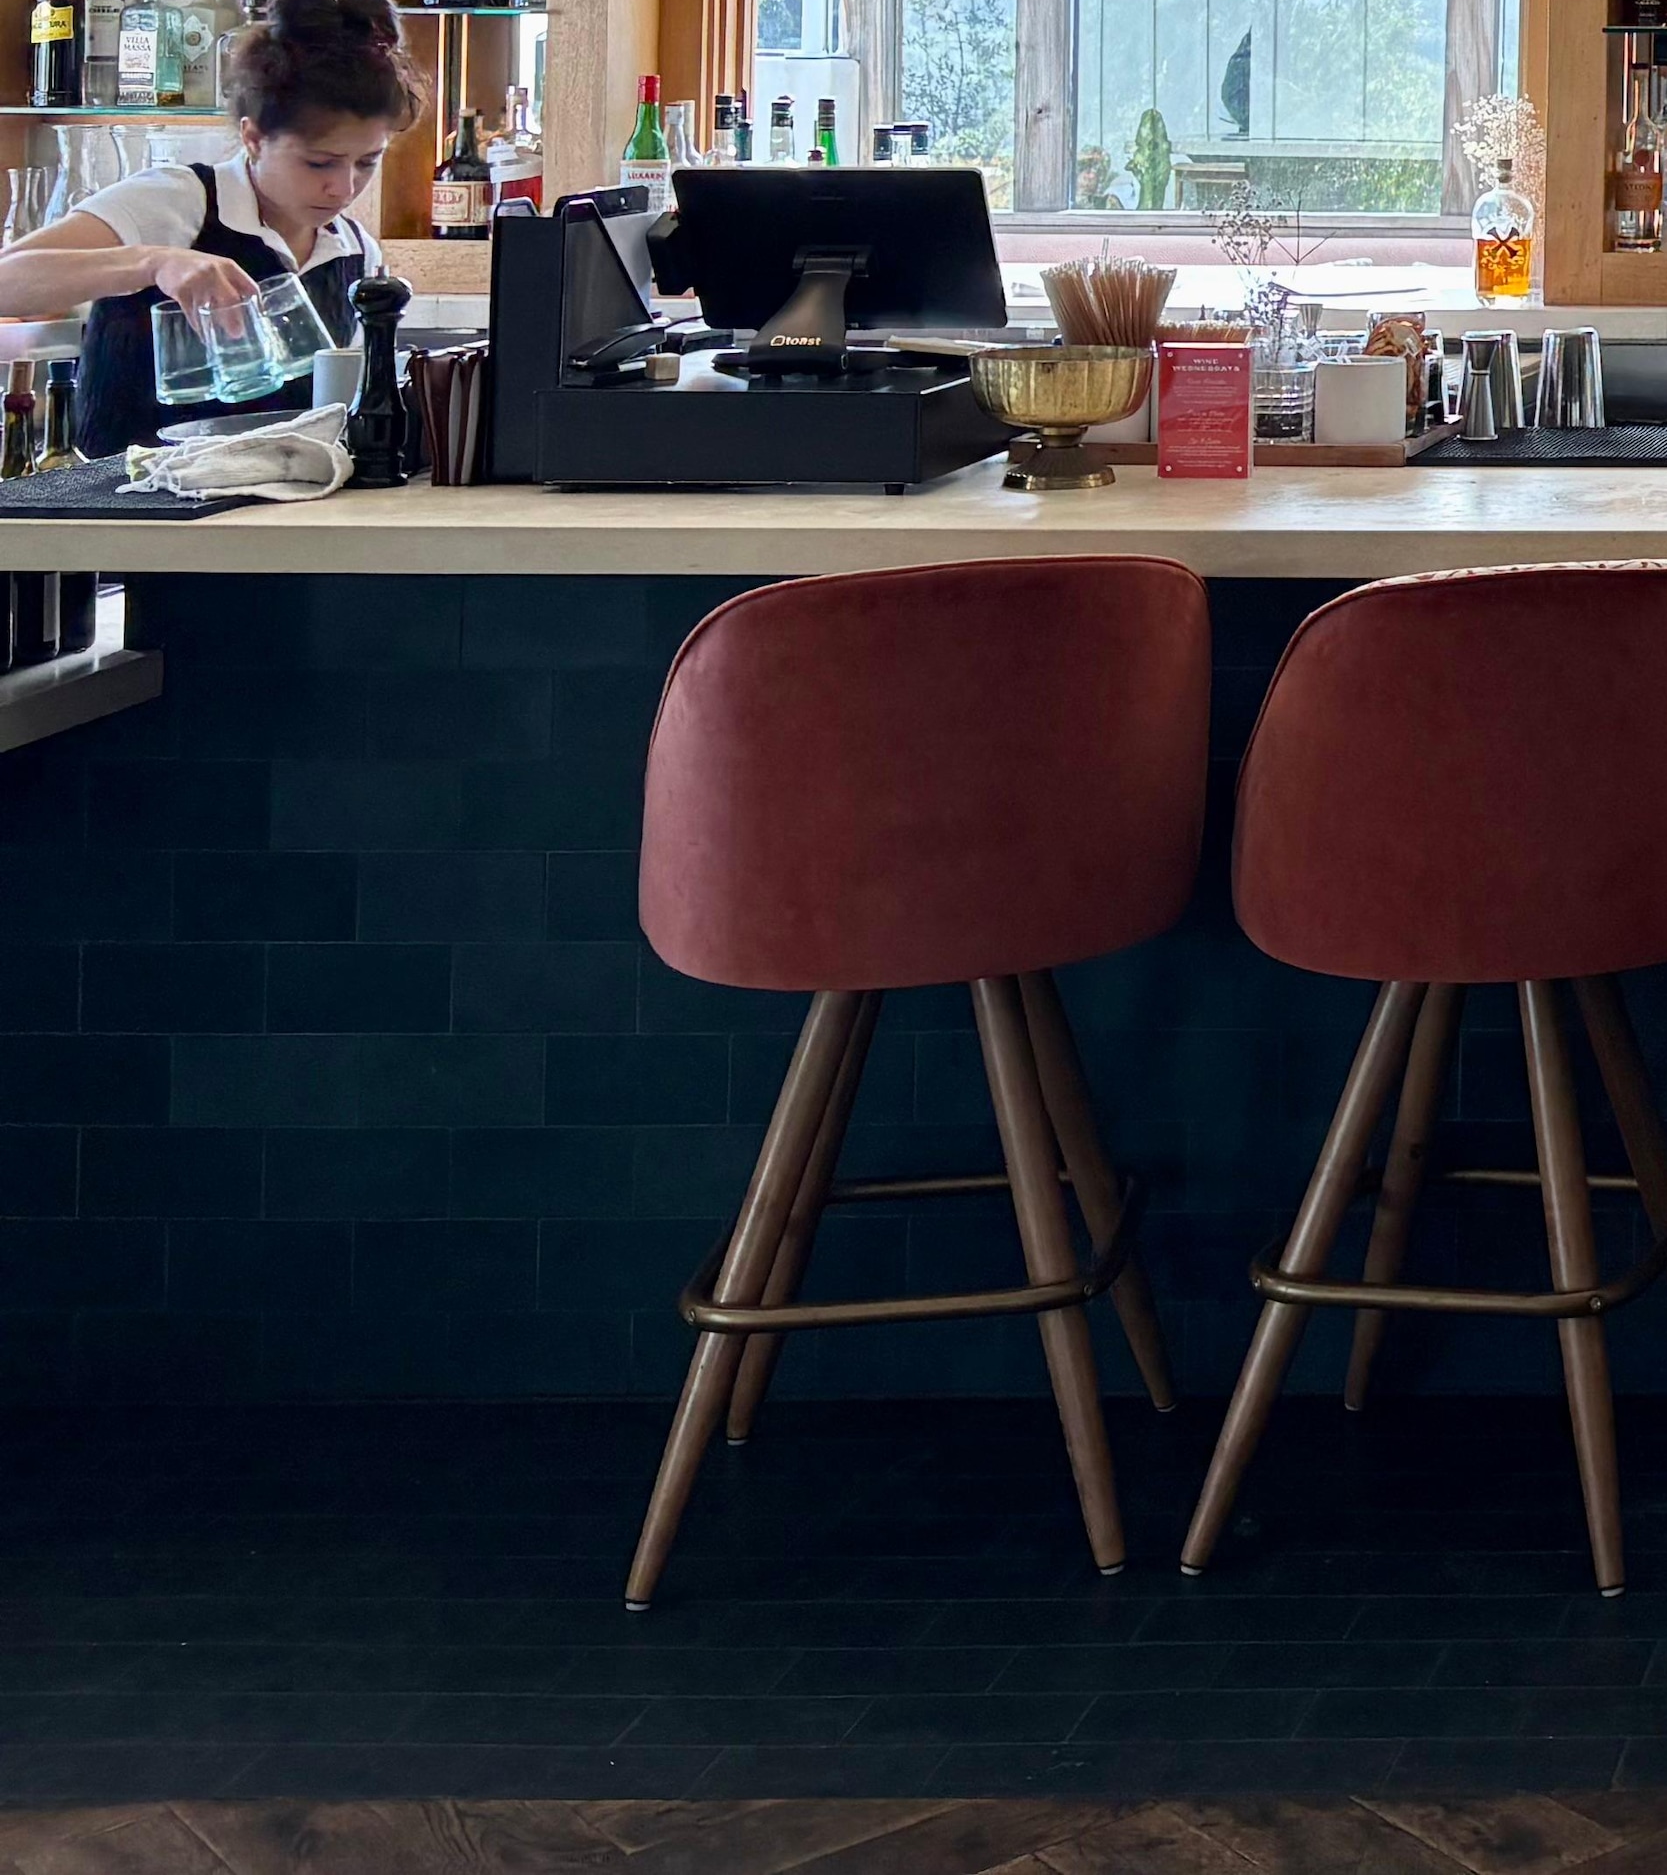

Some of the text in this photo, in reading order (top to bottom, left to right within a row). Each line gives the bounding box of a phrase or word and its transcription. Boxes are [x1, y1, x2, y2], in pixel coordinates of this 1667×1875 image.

[125, 36, 150, 44] VILLA
[123, 44, 151, 52] MASSA
[786, 336, 821, 346] toast
